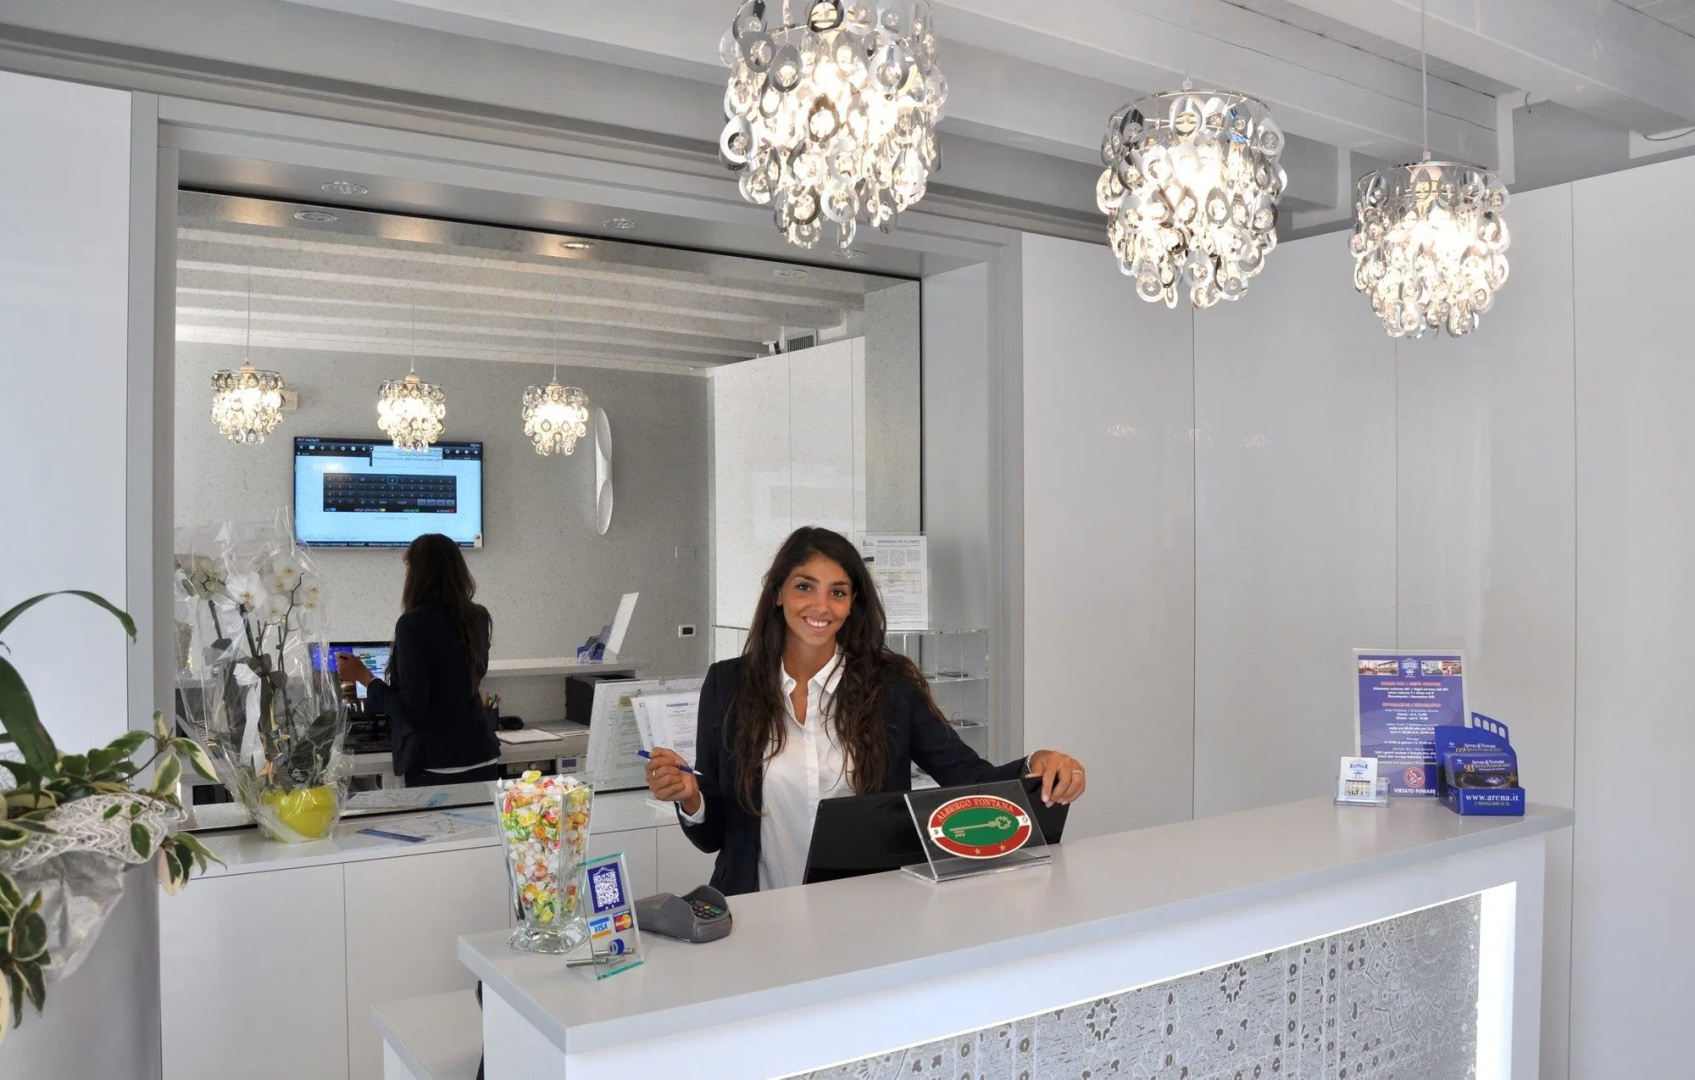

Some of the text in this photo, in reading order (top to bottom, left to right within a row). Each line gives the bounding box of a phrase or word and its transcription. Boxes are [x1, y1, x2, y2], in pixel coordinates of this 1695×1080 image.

[1465, 793, 1519, 801] www.arena.it
[936, 798, 1014, 823] ALBERGO FONTANA
[594, 923, 608, 933] VISA
